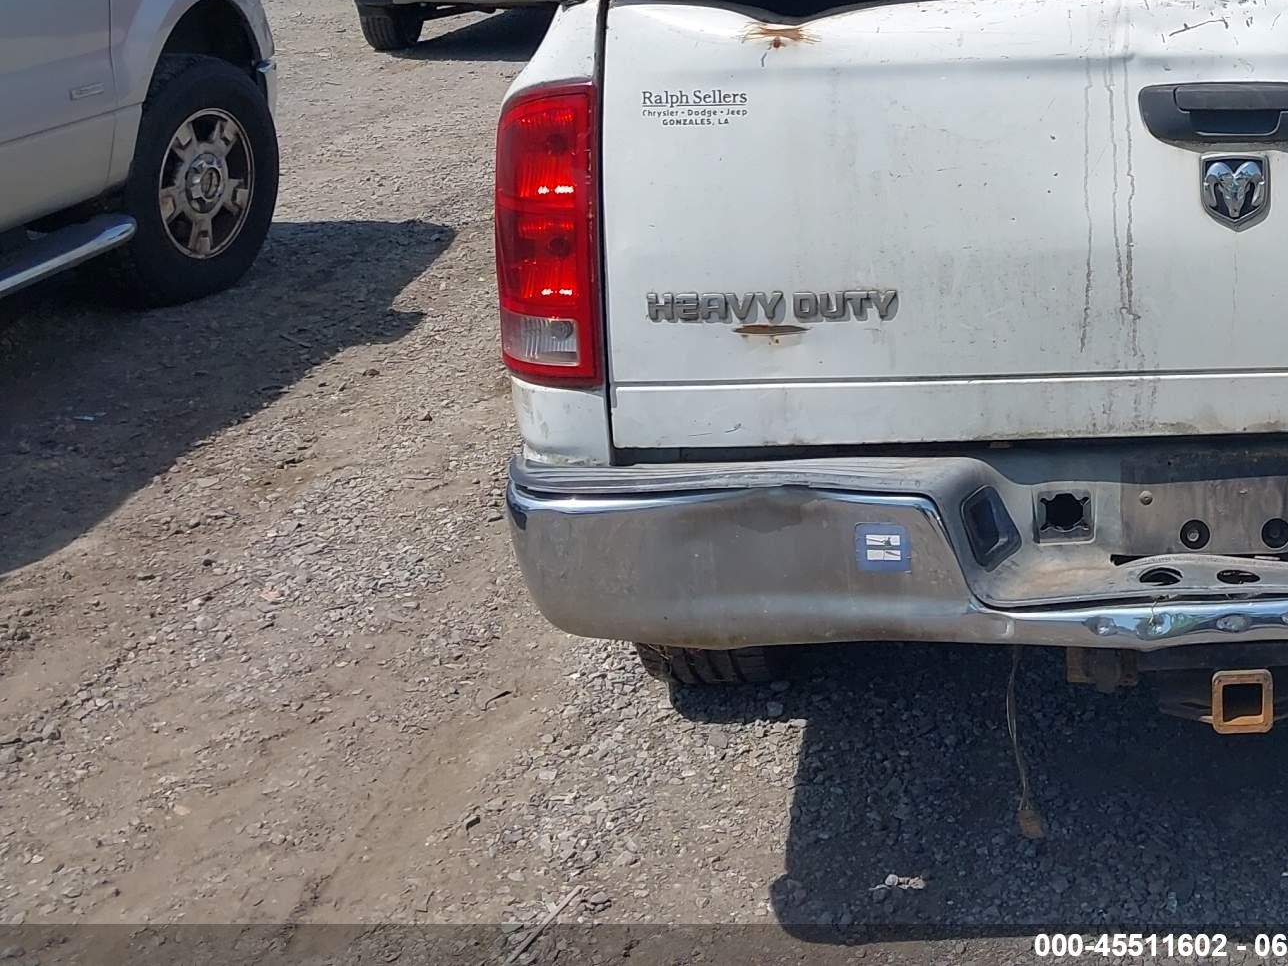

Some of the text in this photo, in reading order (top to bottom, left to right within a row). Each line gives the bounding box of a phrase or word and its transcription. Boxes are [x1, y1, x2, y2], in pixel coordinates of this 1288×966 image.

[641, 89, 748, 108] Ralph Sellers
[642, 108, 748, 118] Chrysler Dodge Jeep
[647, 289, 898, 321] HEAVY DUTY
